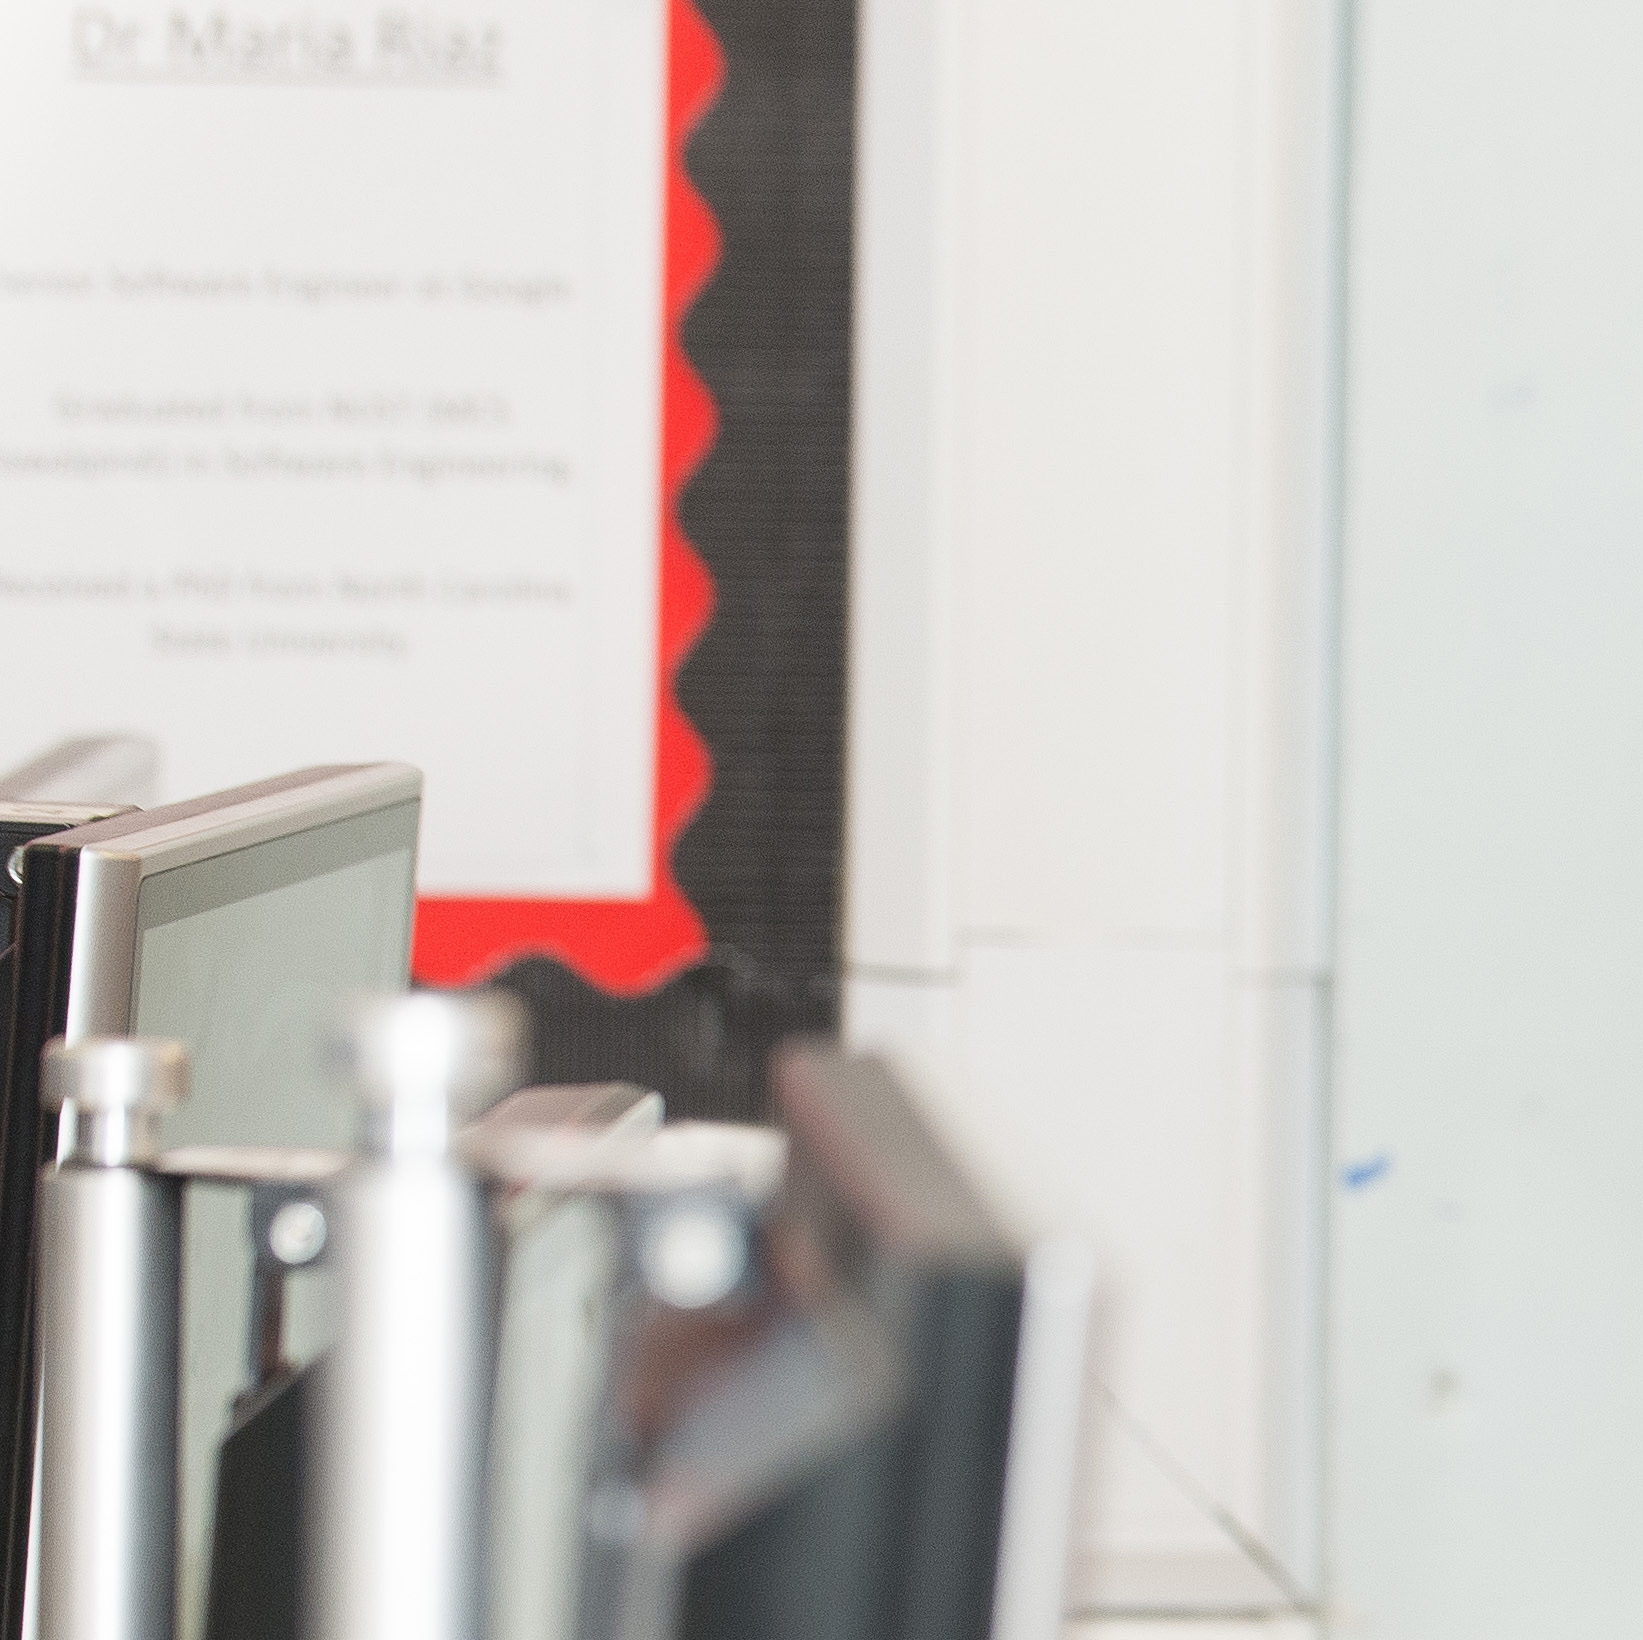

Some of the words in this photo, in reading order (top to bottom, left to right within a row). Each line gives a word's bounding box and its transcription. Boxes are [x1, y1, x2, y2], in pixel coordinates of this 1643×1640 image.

[72, 7, 145, 70] Dr
[168, 7, 354, 73] Maria
[378, 8, 504, 77] Riaz
